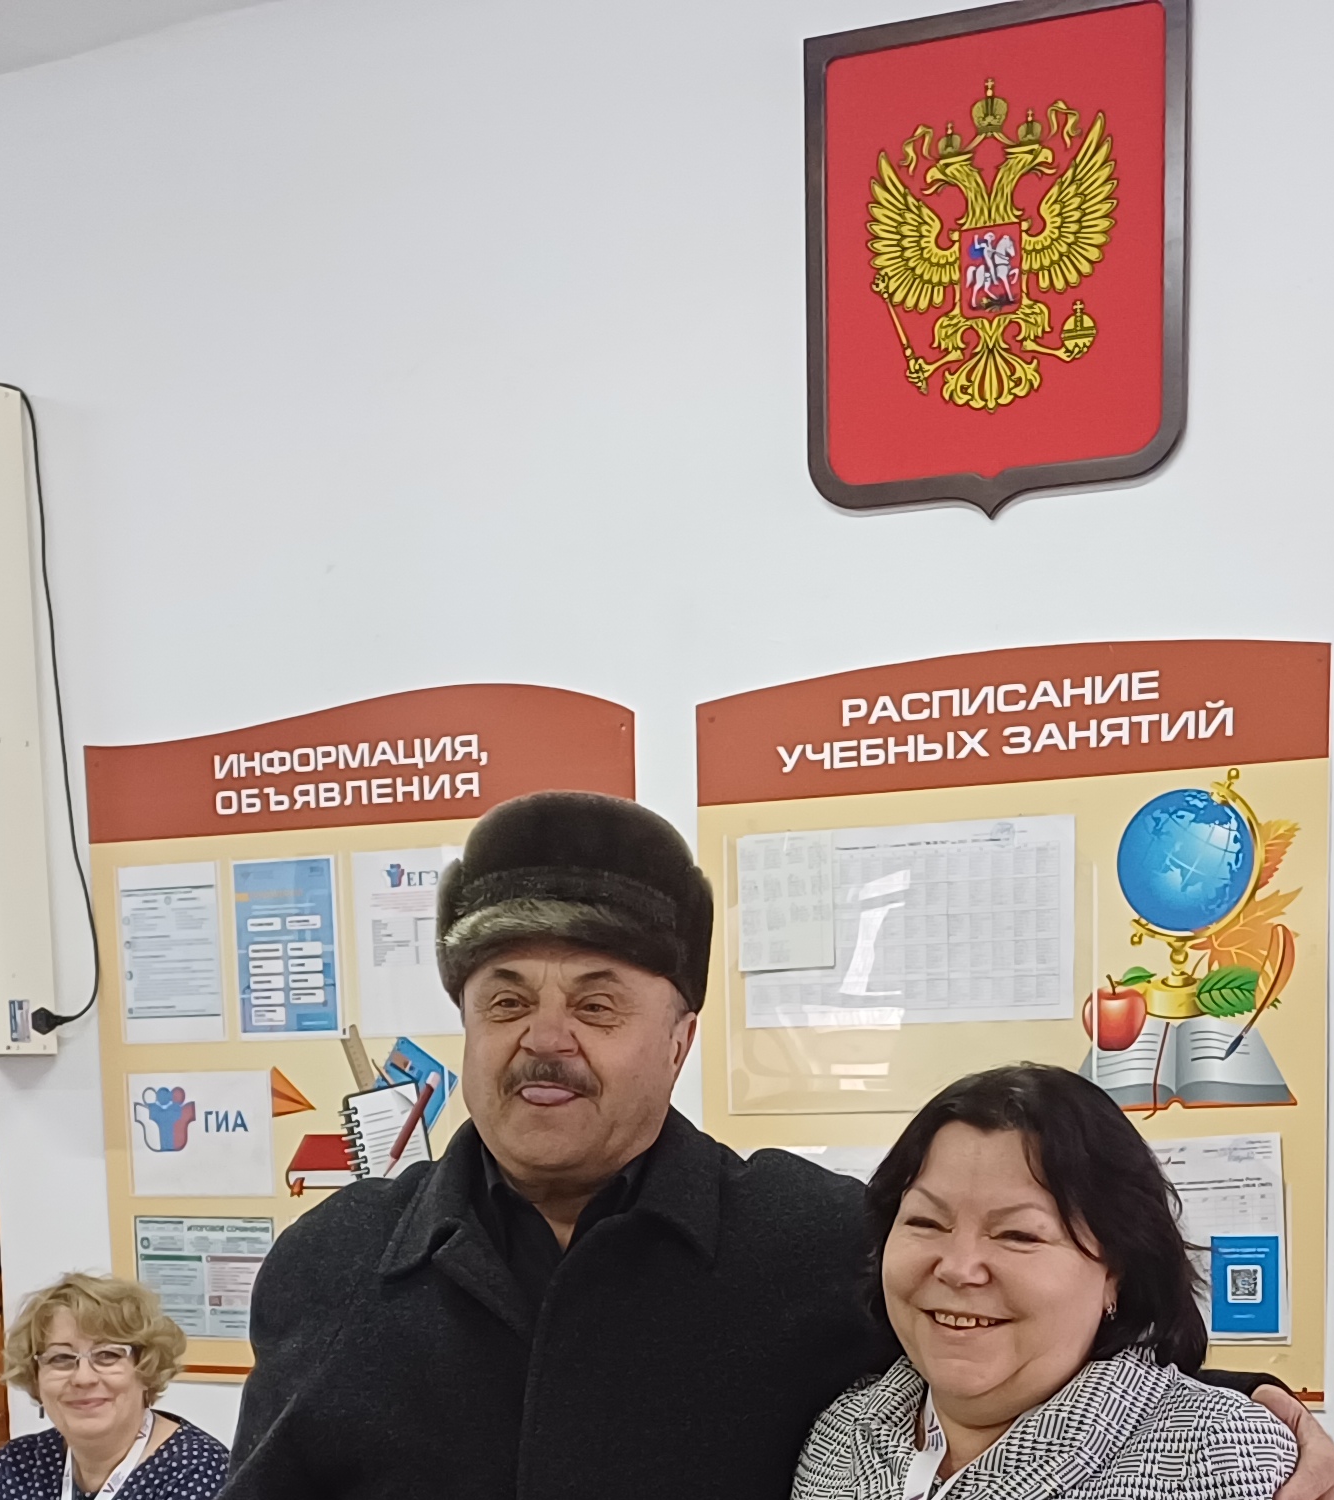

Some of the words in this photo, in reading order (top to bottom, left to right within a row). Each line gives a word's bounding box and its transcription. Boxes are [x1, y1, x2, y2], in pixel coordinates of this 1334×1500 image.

[840, 669, 1161, 728] РАСПИСАНИЕ
[213, 733, 489, 781] ИНФОРМАЦИЯ,
[775, 728, 991, 774] УЧЕБНЫХ
[999, 699, 1236, 755] ЗАНЯТИЙ
[214, 771, 482, 816] ОБЪЯВЛЕНИЯ
[407, 870, 439, 887] ЕГЭ
[202, 1109, 250, 1134] ГИА
